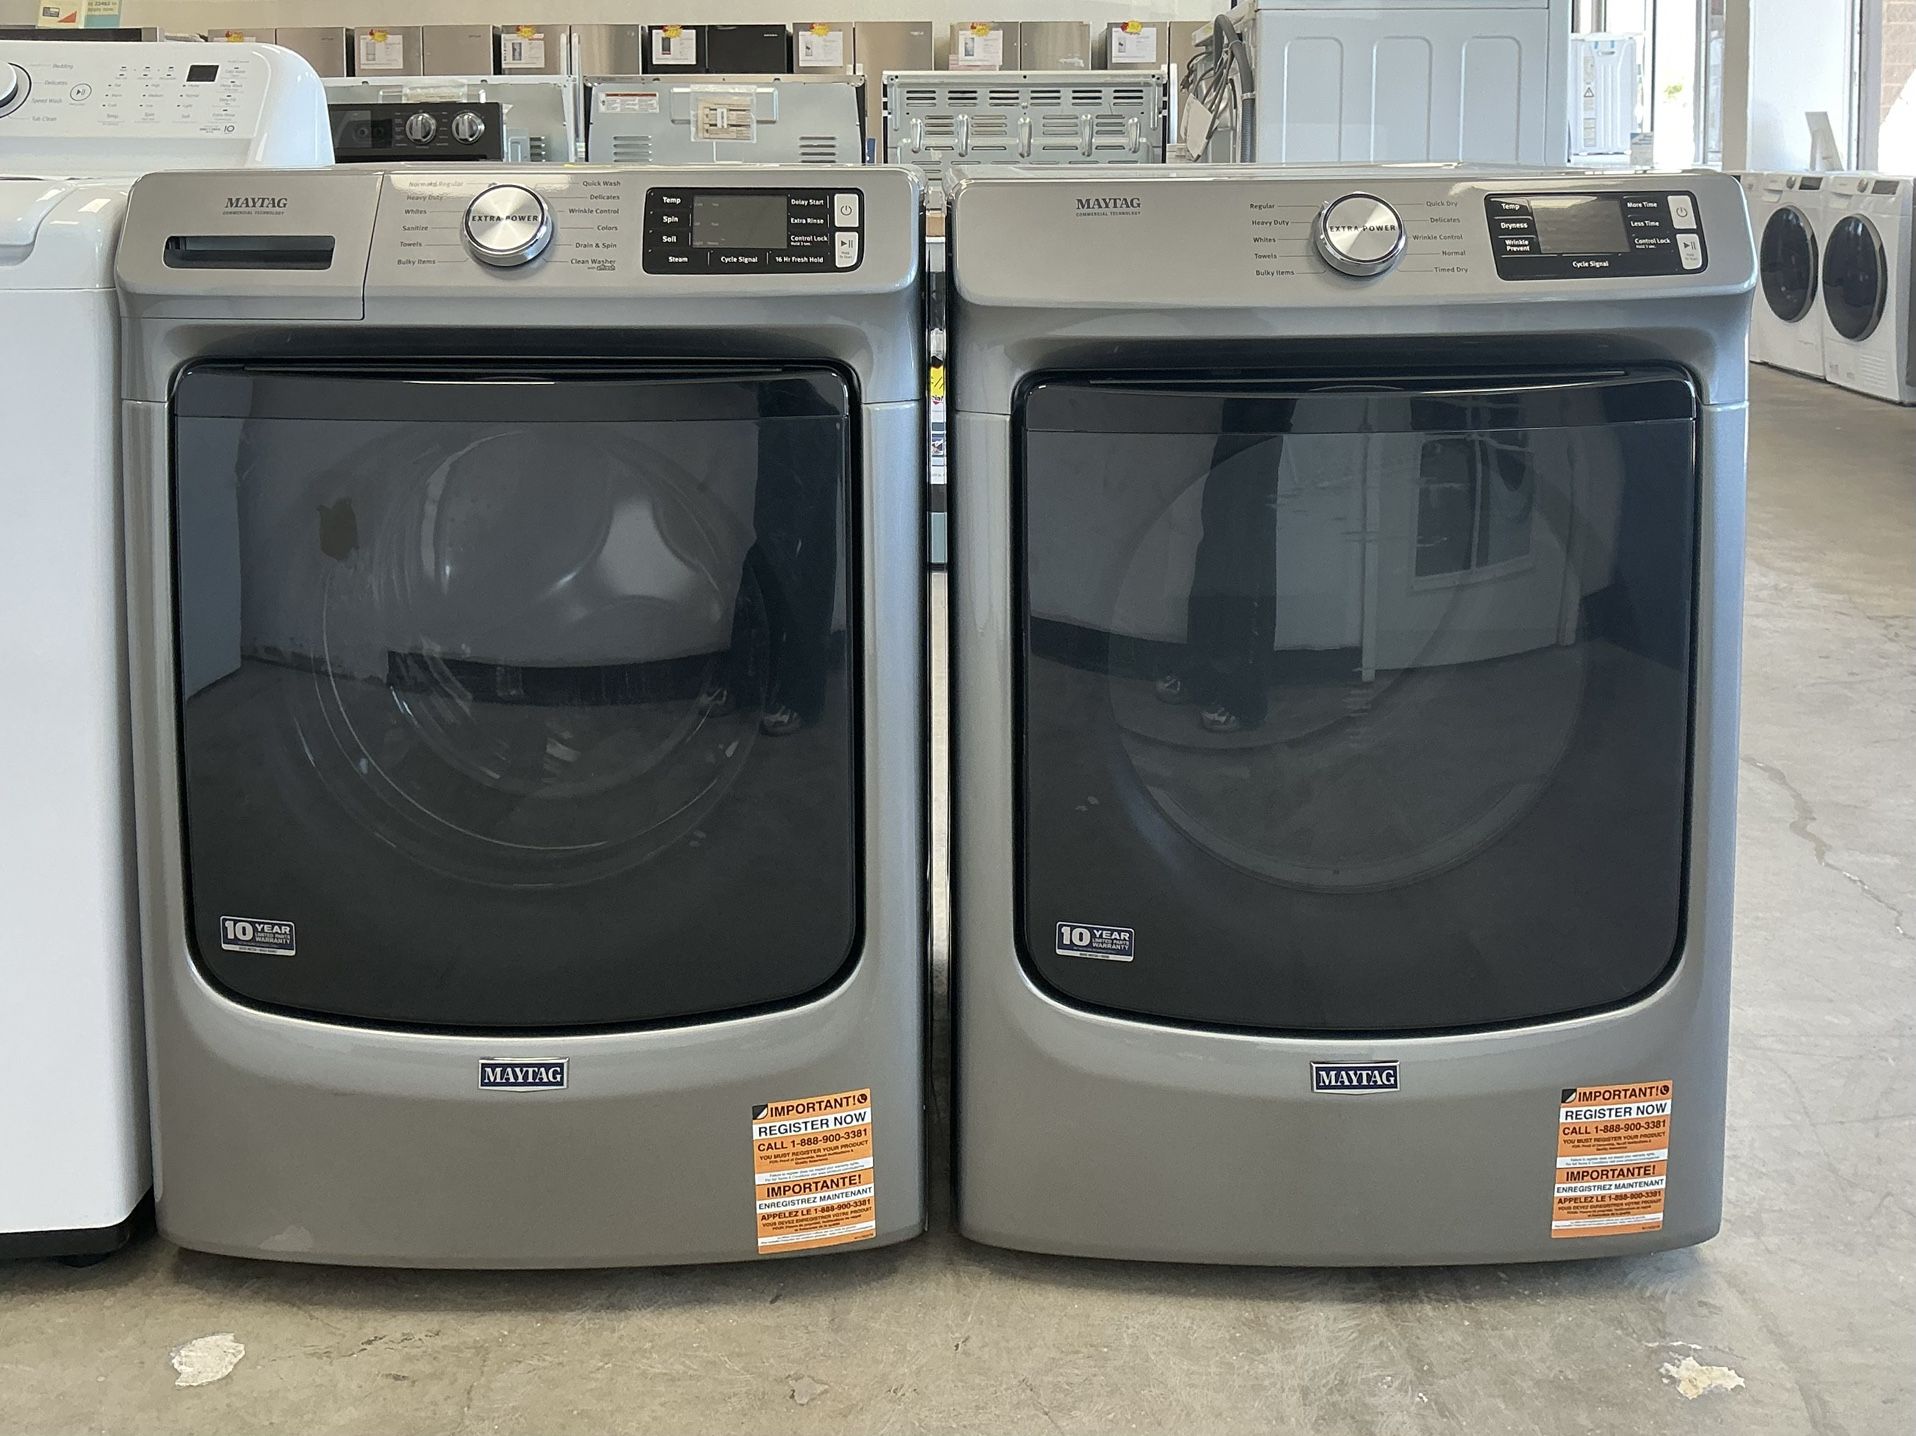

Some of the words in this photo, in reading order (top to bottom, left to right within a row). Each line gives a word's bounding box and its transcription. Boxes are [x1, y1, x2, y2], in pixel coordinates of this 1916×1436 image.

[225, 198, 287, 208] MAYTAG
[1076, 198, 1140, 209] MAYTAG
[225, 920, 253, 940] 10
[255, 924, 290, 934] YEAR
[1061, 927, 1090, 946] 10
[1093, 930, 1129, 940] YEAR
[484, 1067, 562, 1082] MAYTAG
[1319, 1070, 1395, 1085] MAYTAG
[1578, 1086, 1659, 1102] IMPORTANT!
[770, 1095, 856, 1117] IMPORTANT!
[1565, 1107, 1632, 1120] REGISTER
[1636, 1103, 1667, 1116] NOW
[759, 1118, 830, 1137] REGISTER
[834, 1111, 867, 1127] NOW
[1563, 1127, 1591, 1135] CALL
[1594, 1119, 1666, 1134] 1-888-900-3381
[758, 1141, 787, 1151] CALL
[791, 1128, 868, 1148] 1-888-900-3381
[840, 1140, 868, 1149] PRODUCT
[1566, 1165, 1656, 1181] IMPORTANTE!
[766, 1174, 861, 1197] IMPORTANTE!
[1556, 1184, 1612, 1193] ENREGISTREZ
[1614, 1179, 1664, 1190] MAINTENANT
[759, 1197, 818, 1210] ENREGISTREZ
[820, 1187, 872, 1202] MAINTENANT
[761, 1211, 799, 1221] APPELEZ
